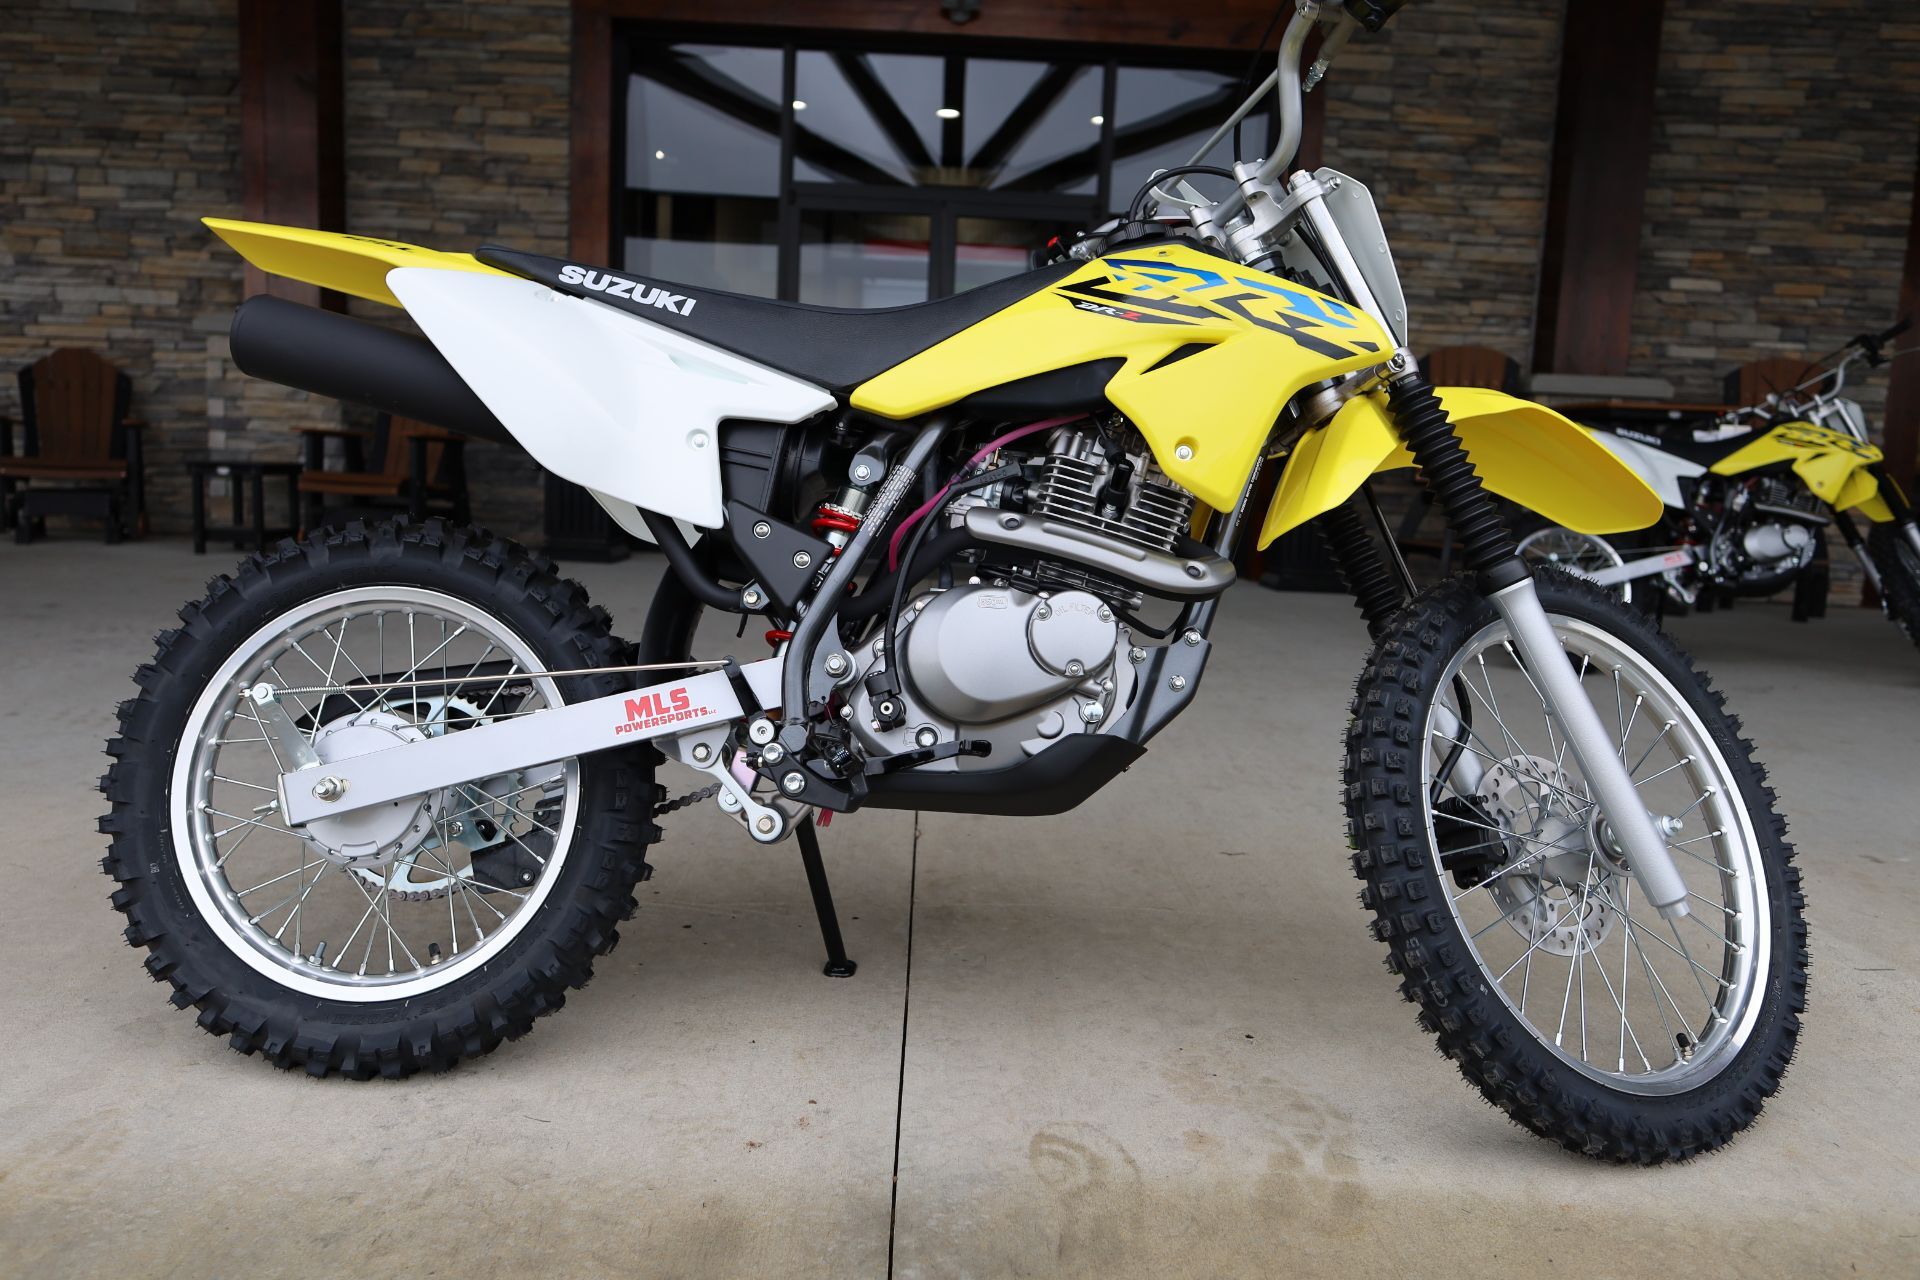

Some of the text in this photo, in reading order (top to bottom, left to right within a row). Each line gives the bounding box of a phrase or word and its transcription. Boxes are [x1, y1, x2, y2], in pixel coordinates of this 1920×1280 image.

[558, 265, 697, 317] SUZUKI
[1075, 301, 1143, 321] DR-Z
[615, 706, 708, 735] POWERSPORTS
[625, 688, 690, 722] MLS
